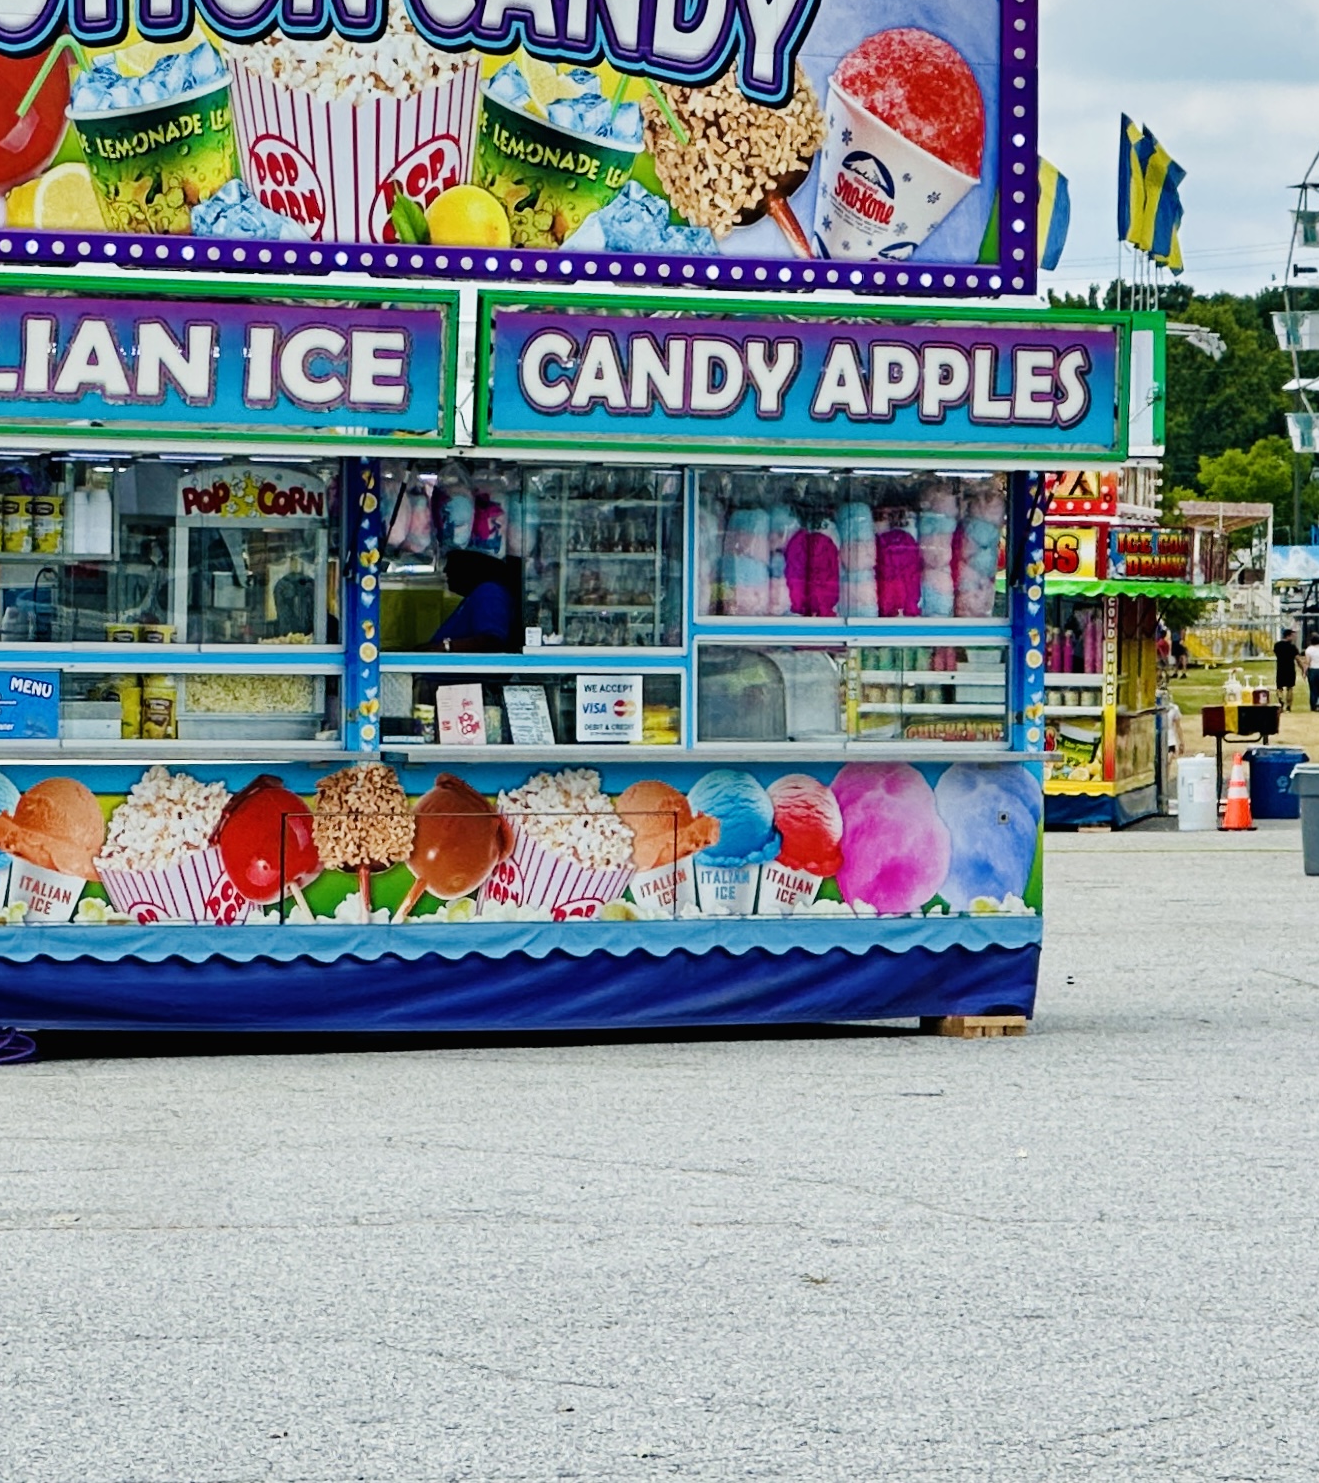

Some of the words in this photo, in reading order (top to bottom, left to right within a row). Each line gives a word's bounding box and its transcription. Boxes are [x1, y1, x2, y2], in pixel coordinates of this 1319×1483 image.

[94, 111, 203, 160] LEMONADE
[493, 121, 601, 183] LEMONADE
[253, 151, 299, 187] POP
[245, 324, 411, 410] ICE
[520, 327, 799, 416] CANDY
[812, 339, 1088, 426] APPLES
[182, 484, 230, 517] POP
[256, 485, 325, 517] CORN
[1118, 532, 1152, 554] ICE
[9, 676, 53, 698] MENU
[584, 683, 597, 694] WE
[599, 683, 633, 694] ACCEPT
[582, 702, 608, 715] VISA
[18, 874, 73, 906] ITALIAN
[639, 869, 687, 898] ITALIAN
[700, 868, 750, 887] ITALIAN
[764, 866, 814, 897] ITALIAN
[28, 895, 53, 916] ICE
[656, 888, 679, 908] ICE
[714, 885, 736, 902] ICE
[775, 886, 798, 906] ICE
